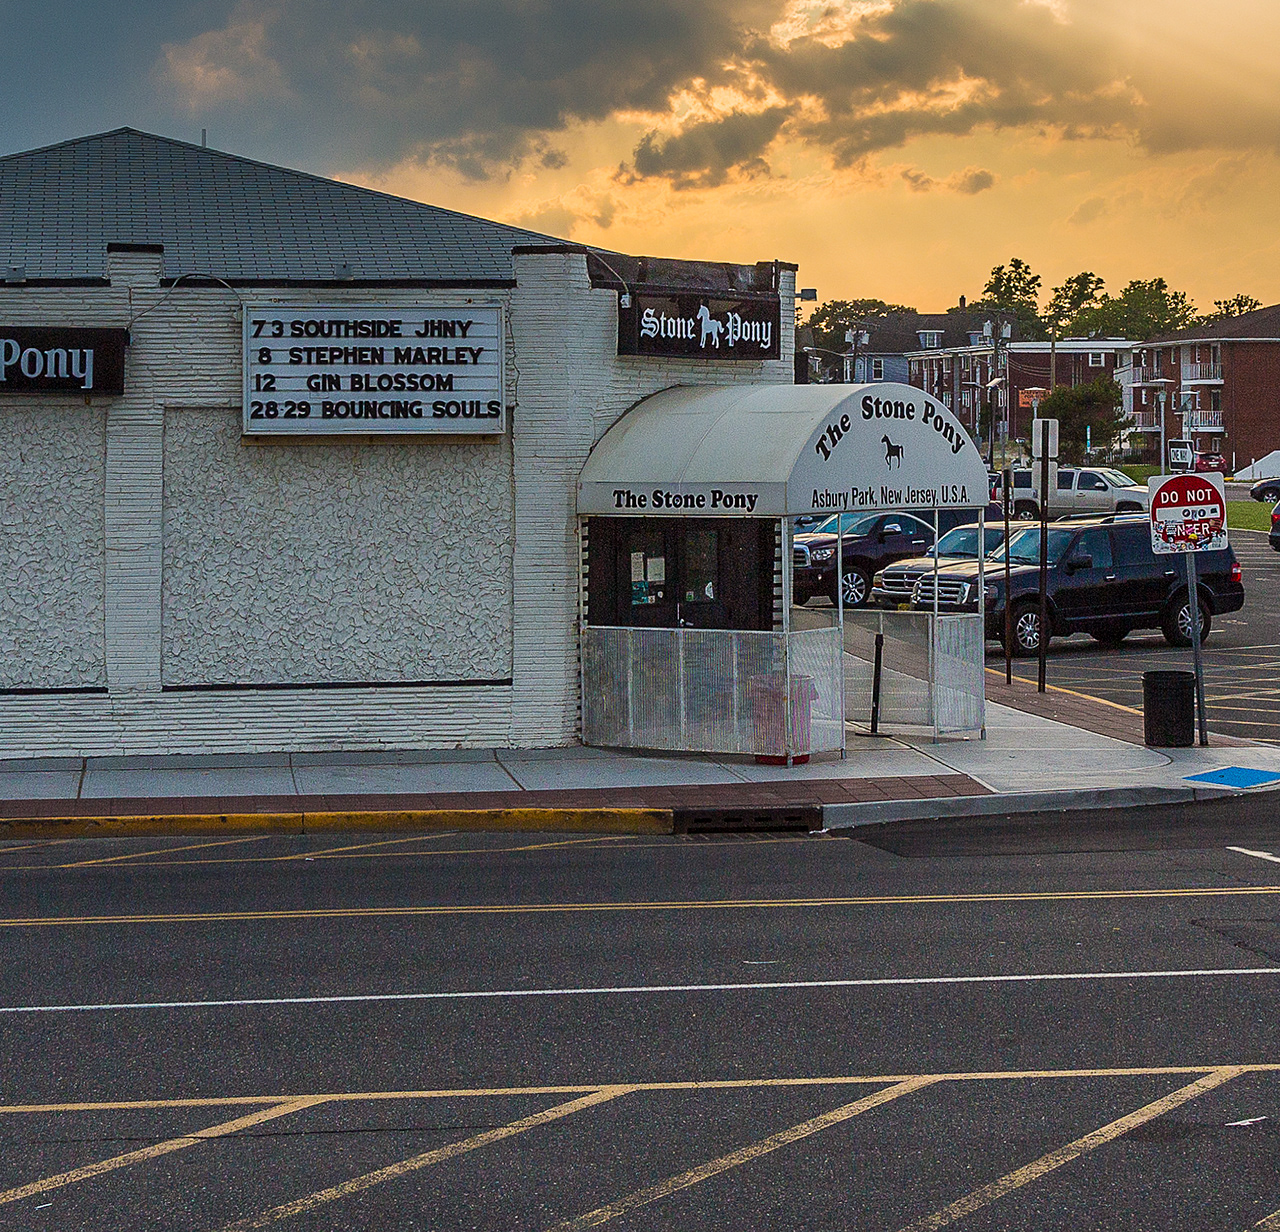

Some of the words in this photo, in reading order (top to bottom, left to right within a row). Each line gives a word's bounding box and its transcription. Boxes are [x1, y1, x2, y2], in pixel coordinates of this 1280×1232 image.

[290, 320, 402, 338] SOUTHSIDE
[415, 320, 473, 338] JHNY
[640, 308, 696, 339] Stone
[725, 311, 772, 349] Pony
[258, 347, 271, 365] 8
[289, 347, 384, 365] STEPHEN
[394, 347, 484, 365] MARLEY
[255, 373, 276, 392] 12
[306, 373, 341, 392] GIN
[350, 373, 454, 392] BLOSSOM
[322, 401, 422, 418] BOUNCING
[432, 400, 501, 418] SOULS
[815, 414, 851, 462] The
[861, 395, 915, 421] Stone
[922, 400, 966, 454] Pony
[612, 489, 647, 508] The
[651, 489, 706, 508] Stone
[710, 489, 758, 512] Pony
[811, 489, 848, 510] Asbury
[851, 486, 878, 507] Park,
[880, 486, 902, 504] New
[904, 485, 939, 507] Jersey,
[941, 485, 970, 503] U.S.A.
[1161, 490, 1179, 504] DO
[1186, 489, 1212, 502] NOT
[1168, 523, 1210, 537] NTER
